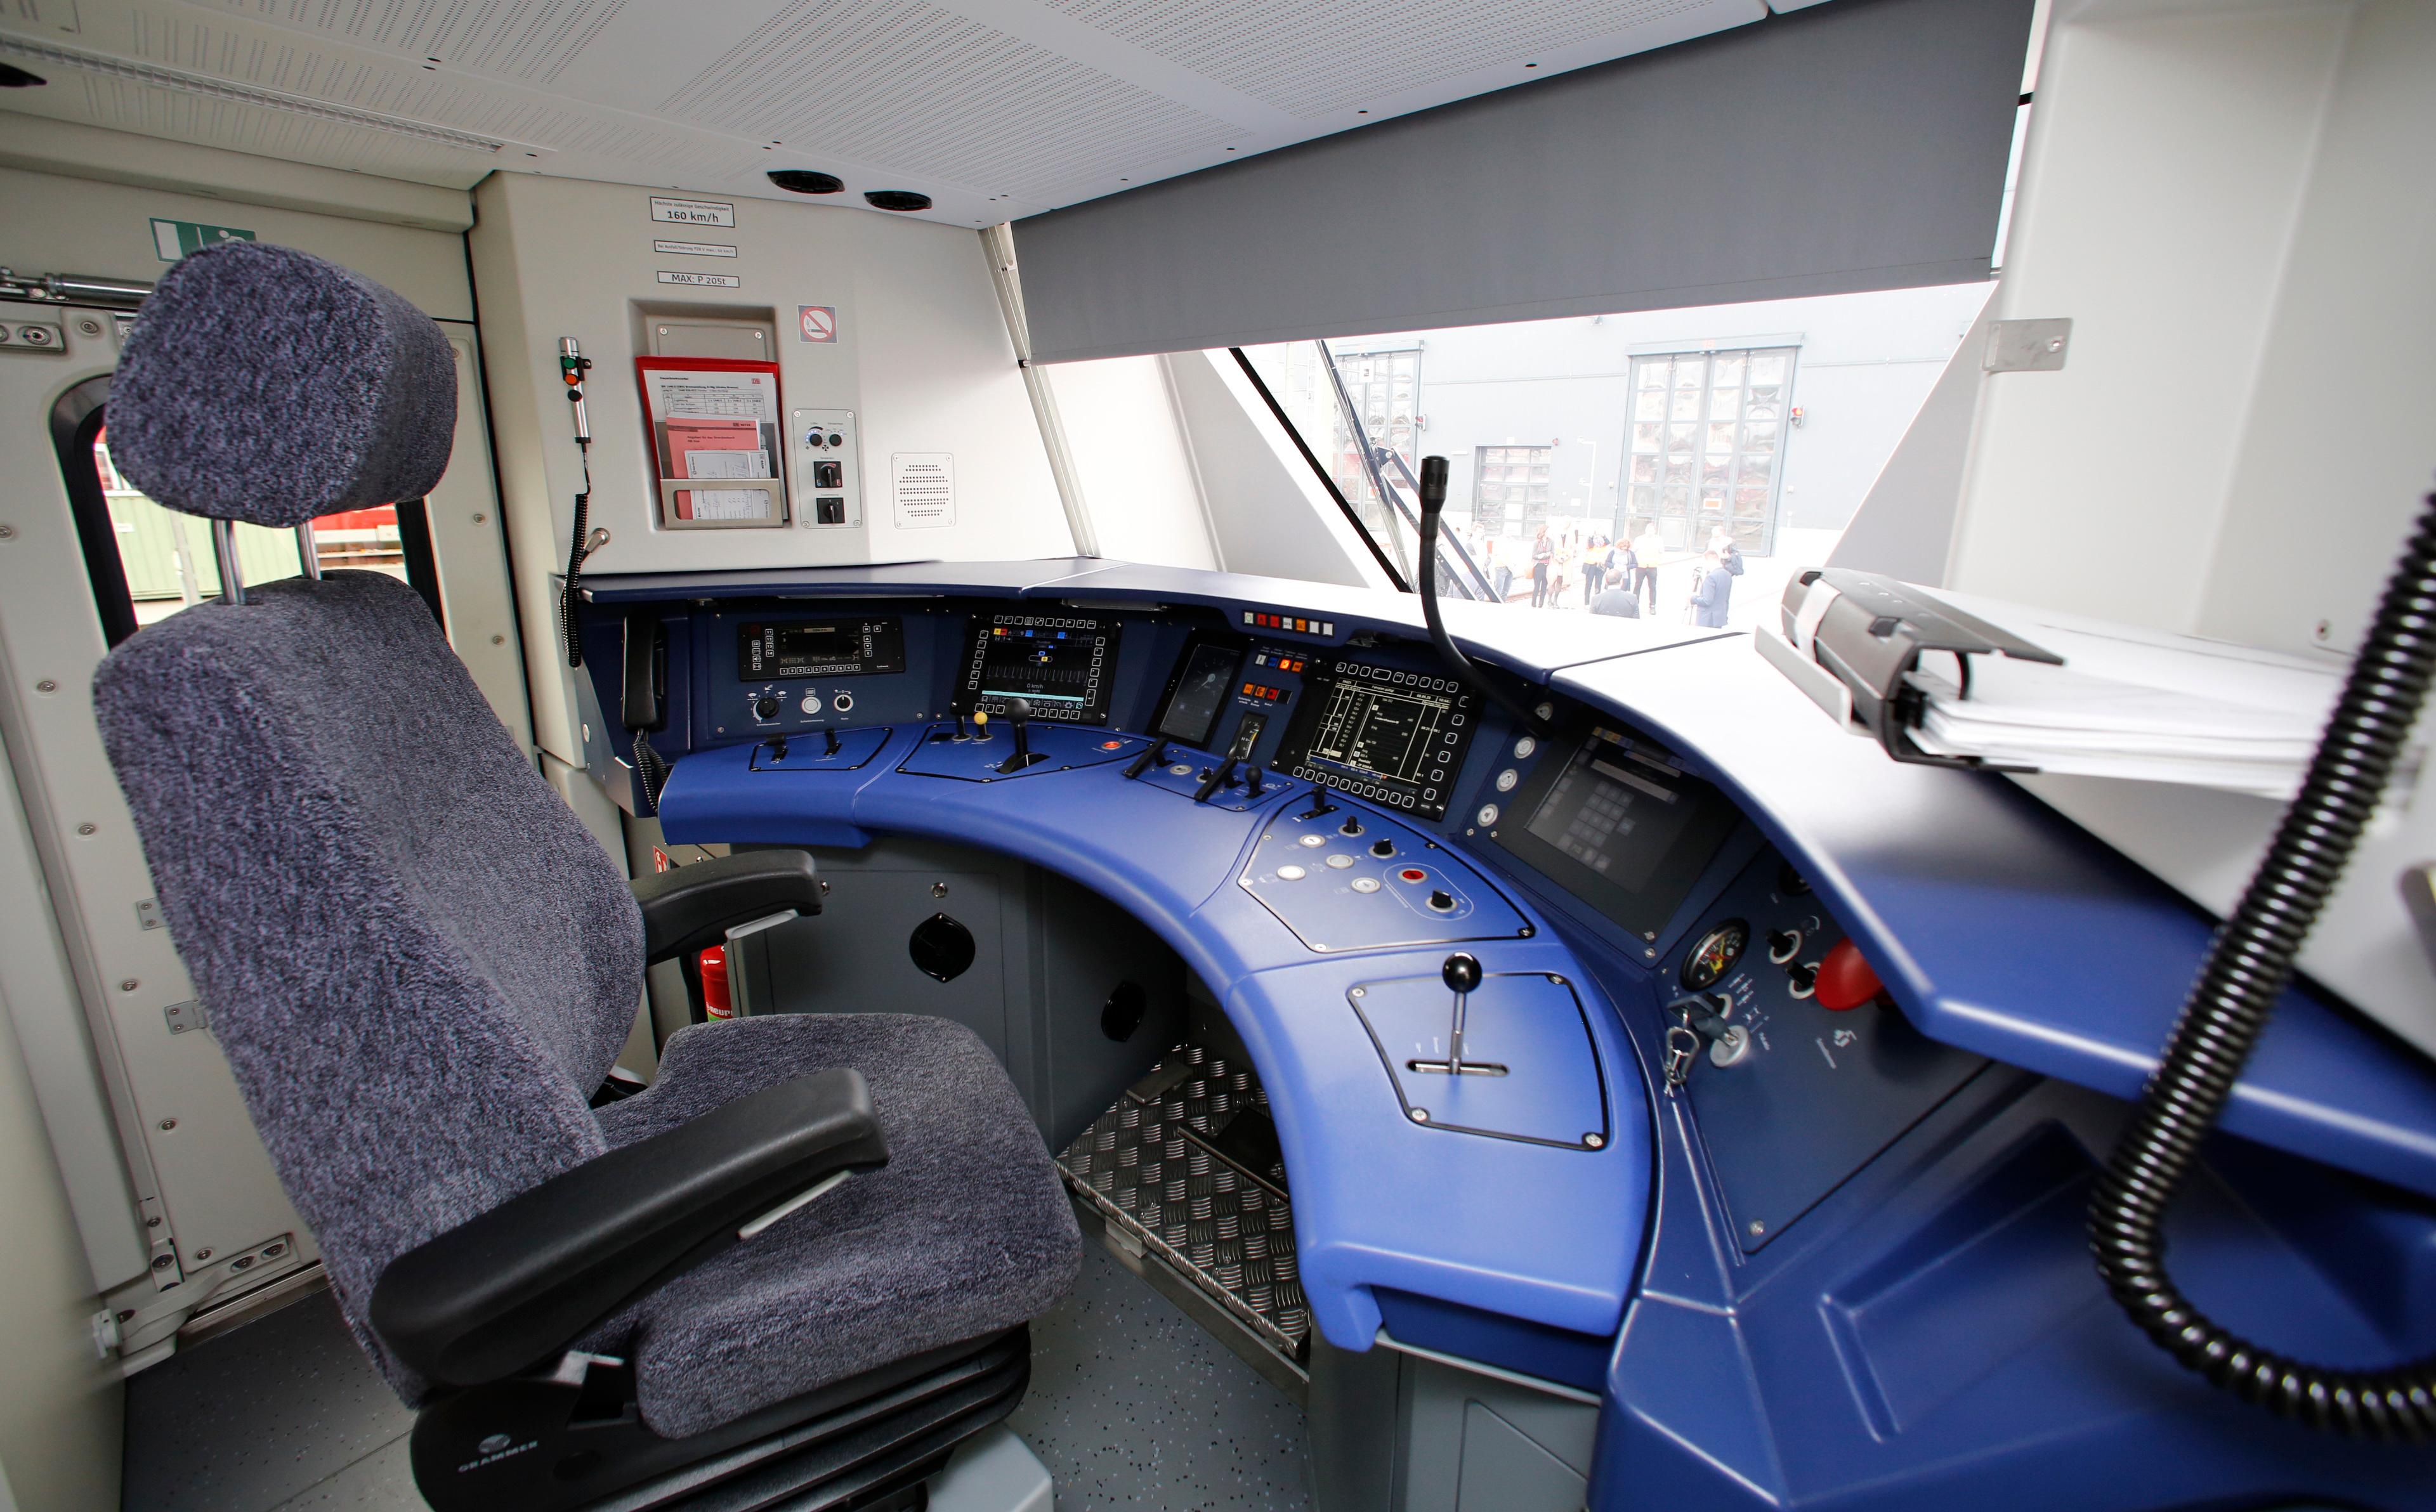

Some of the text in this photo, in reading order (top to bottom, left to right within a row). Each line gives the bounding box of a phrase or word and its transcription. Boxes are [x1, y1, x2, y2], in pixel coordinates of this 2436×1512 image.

[695, 204, 730, 212] Geschwindigkeit
[667, 211, 719, 223] 160 km/h
[672, 274, 695, 283] MAX:
[707, 277, 726, 285] 205t
[458, 1440, 538, 1473] GRAMMER
